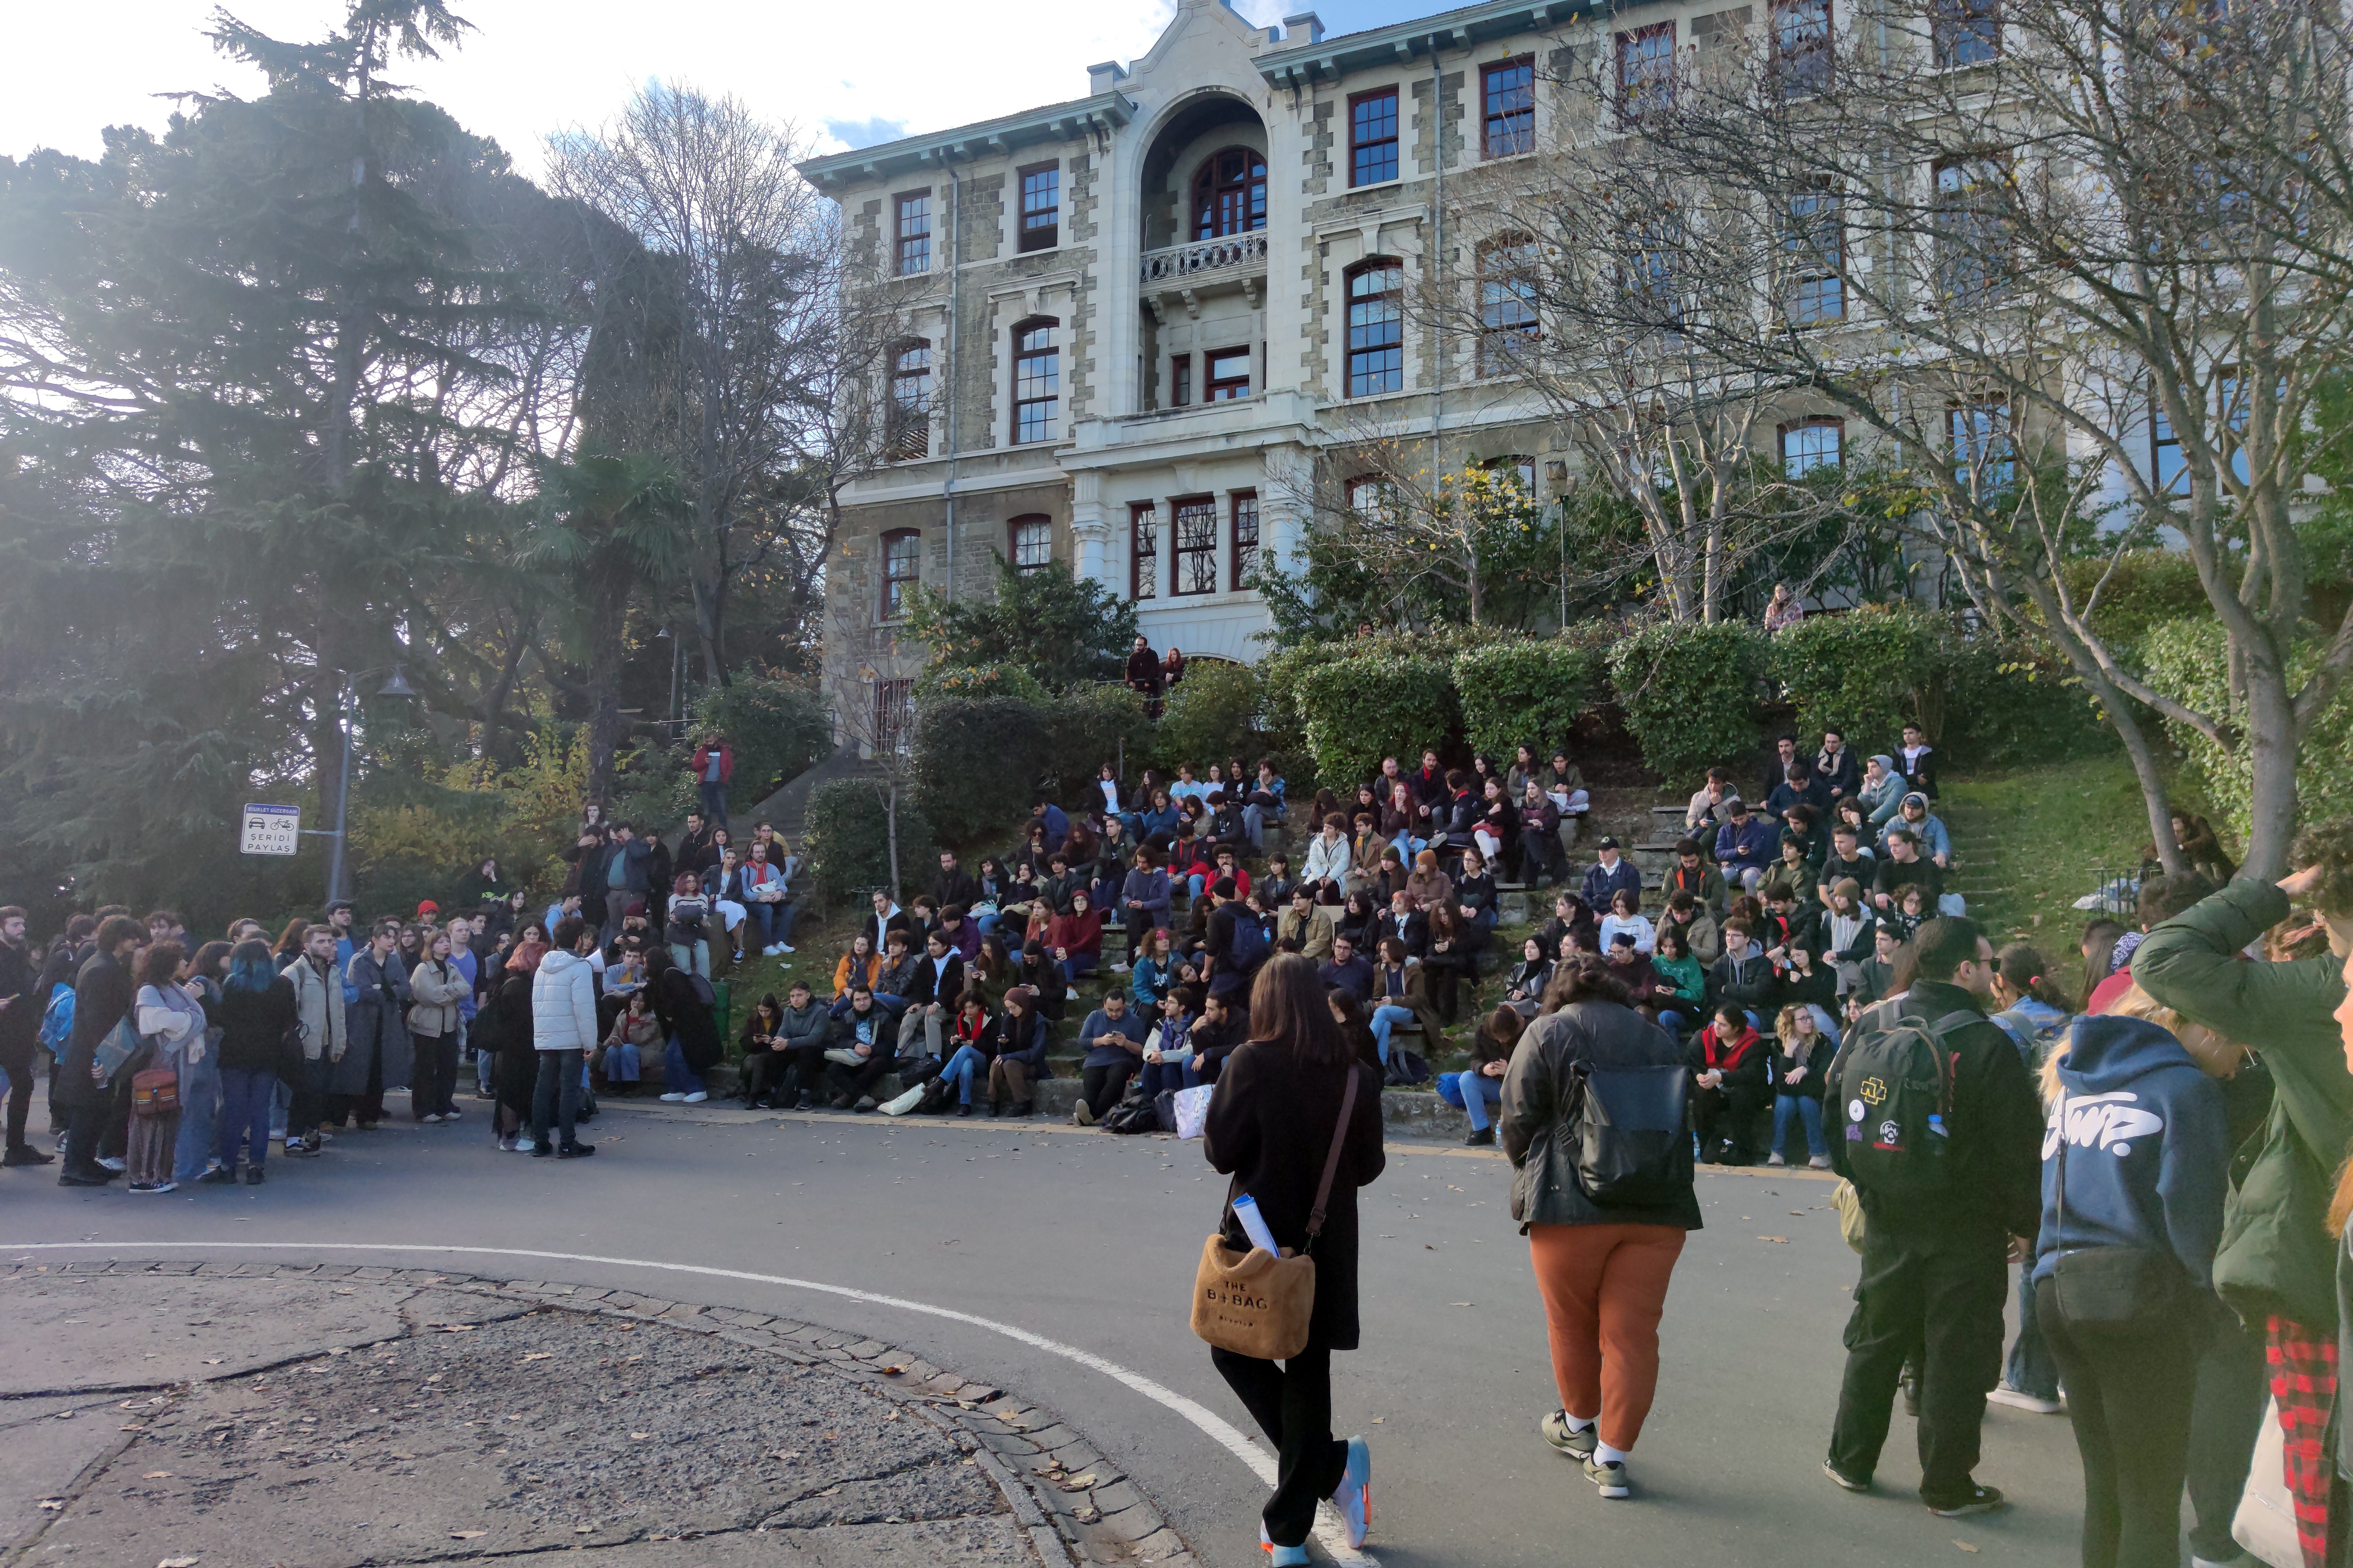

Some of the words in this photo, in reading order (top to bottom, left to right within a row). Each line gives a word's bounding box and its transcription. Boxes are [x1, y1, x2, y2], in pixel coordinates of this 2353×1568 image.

[250, 833, 290, 841] ŞERİDİ
[248, 843, 290, 853] PAYLAŞ
[1225, 1281, 1247, 1291] THE
